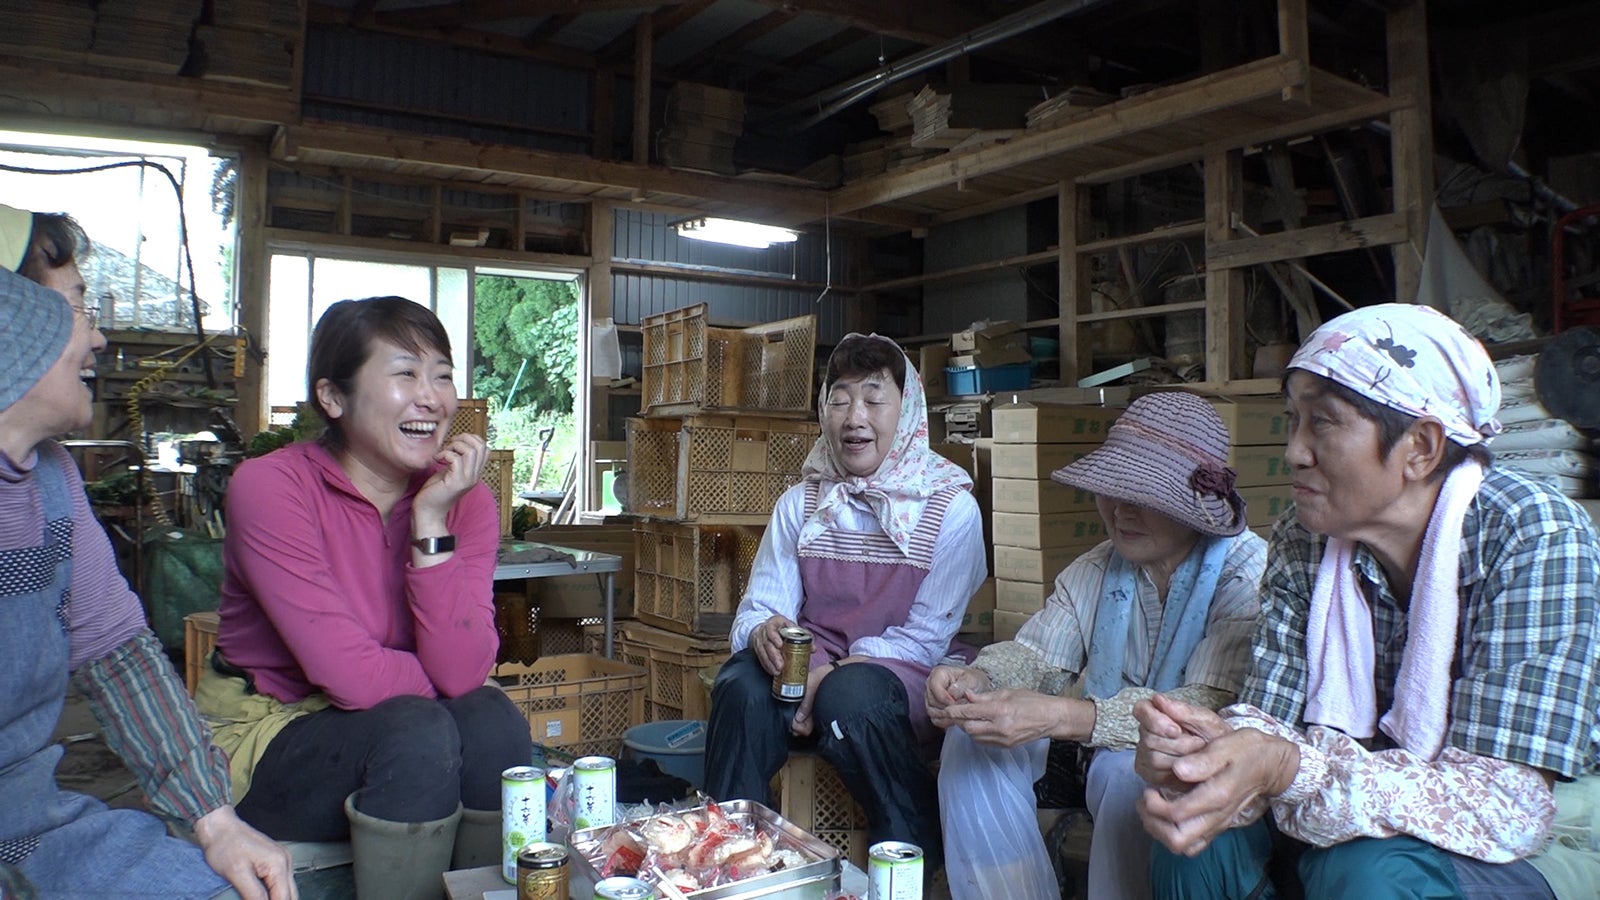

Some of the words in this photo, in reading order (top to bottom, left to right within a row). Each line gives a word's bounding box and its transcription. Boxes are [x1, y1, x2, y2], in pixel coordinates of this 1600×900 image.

[521, 796, 531, 826] 十六茶
[585, 785, 595, 814] 十六茶
